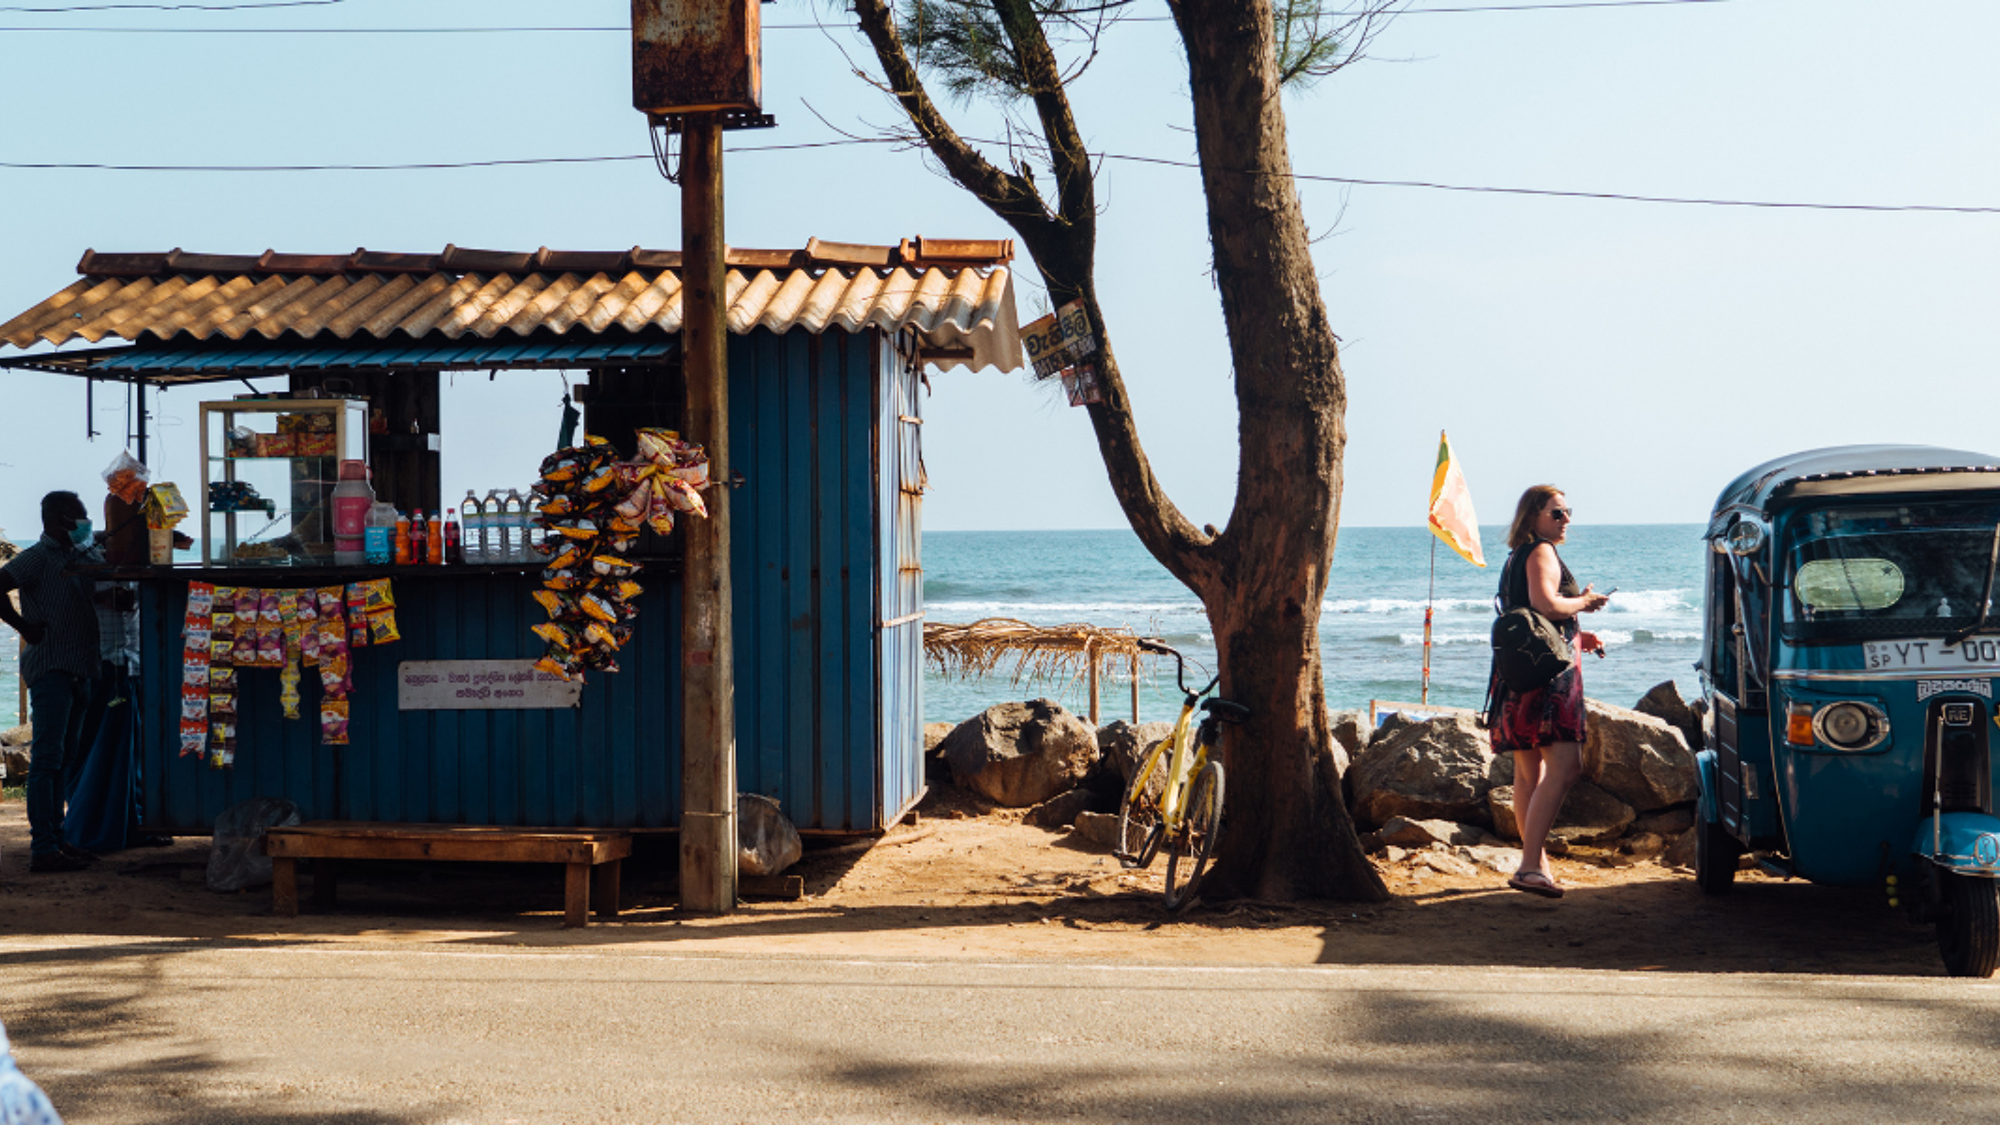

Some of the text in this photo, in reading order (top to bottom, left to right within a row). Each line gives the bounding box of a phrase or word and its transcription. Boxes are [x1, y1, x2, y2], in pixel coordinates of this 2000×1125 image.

[1870, 654, 1891, 668] SP
[1895, 642, 1929, 664] YT
[1962, 641, 2000, 662] 00
[1948, 709, 1968, 721] RE
